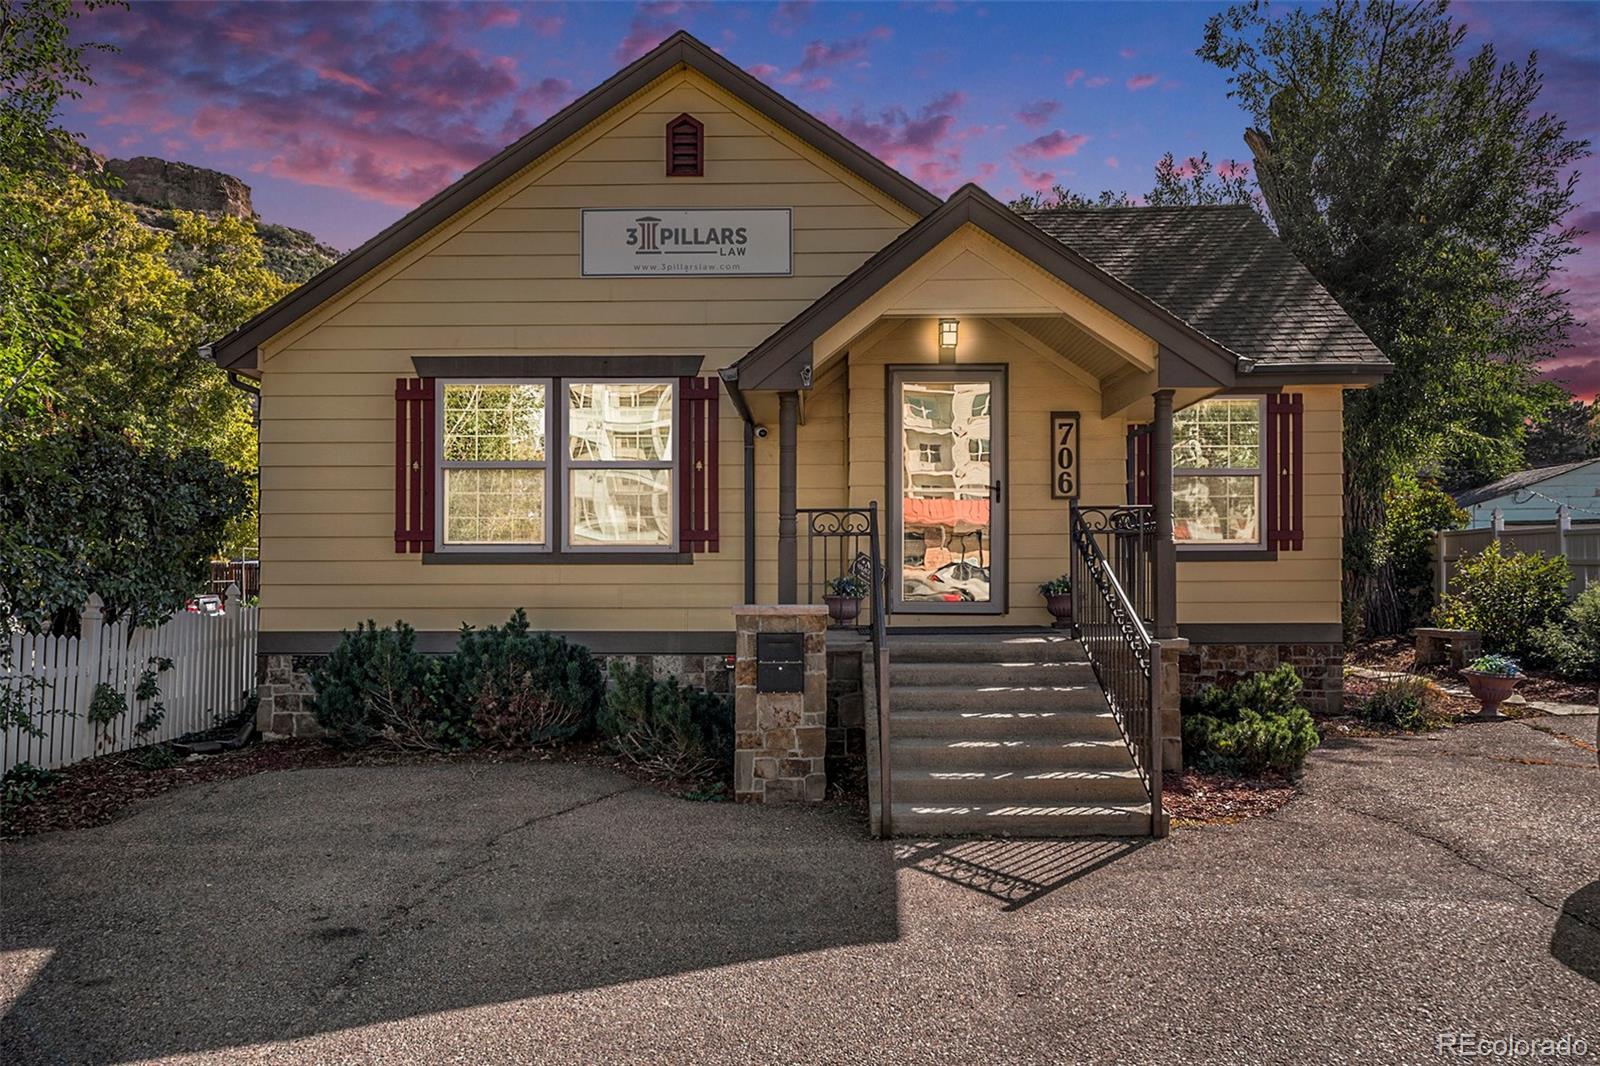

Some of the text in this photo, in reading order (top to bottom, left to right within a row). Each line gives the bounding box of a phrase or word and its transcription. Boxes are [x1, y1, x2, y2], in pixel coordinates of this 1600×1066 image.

[626, 227, 748, 245] 3 PILLARS
[719, 247, 747, 256] LAW
[633, 263, 741, 272] www.3pillarslaw.com
[1058, 423, 1073, 494] 706
